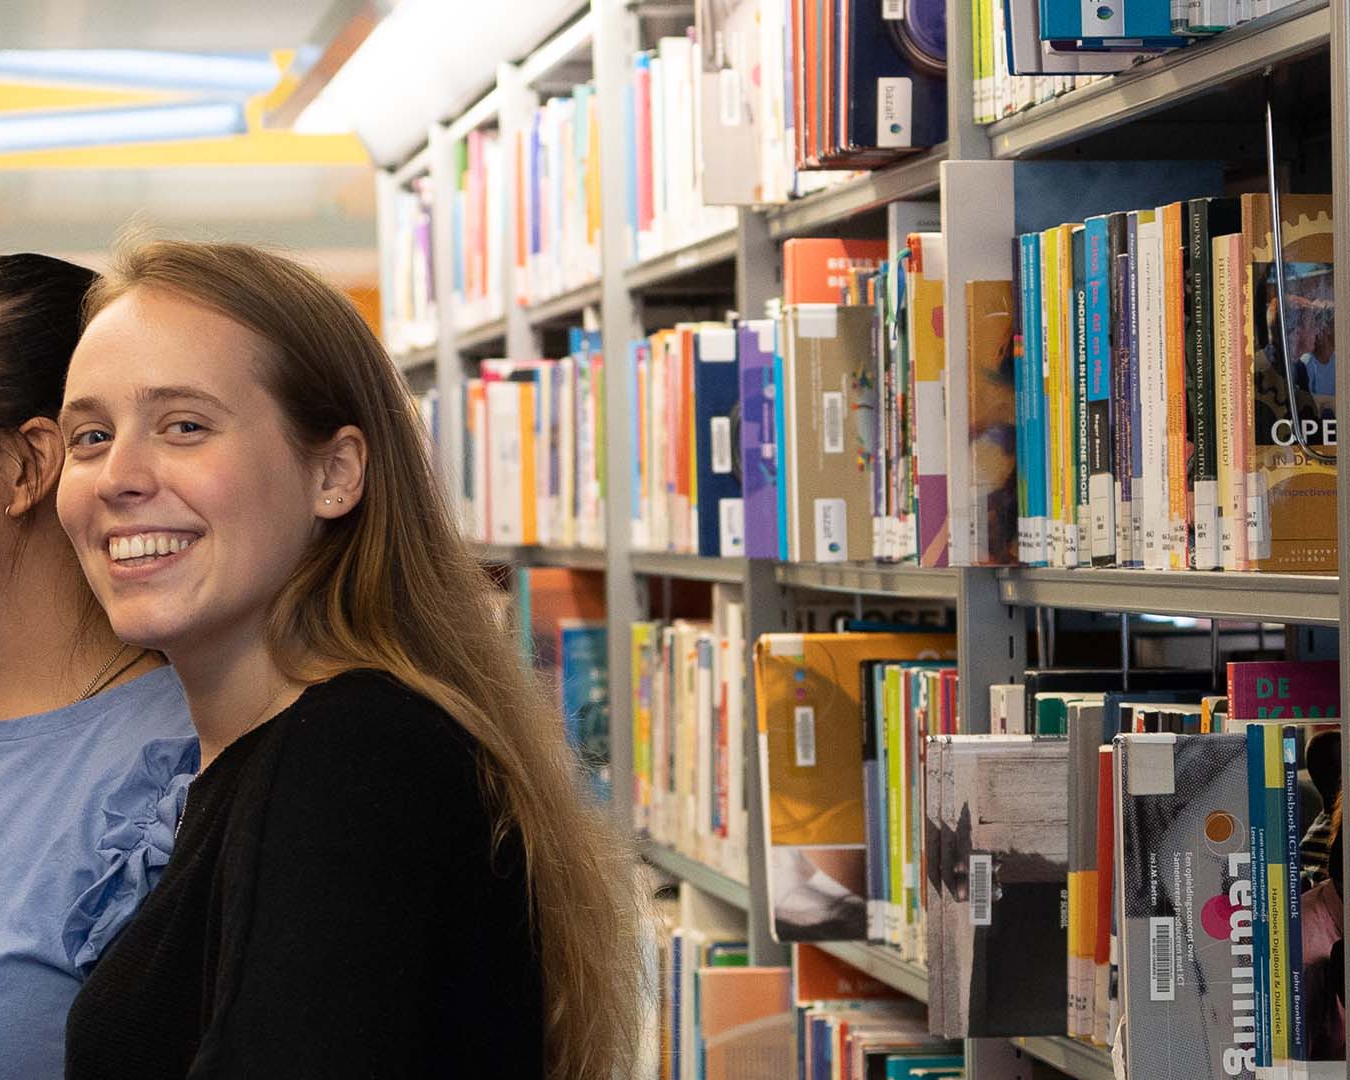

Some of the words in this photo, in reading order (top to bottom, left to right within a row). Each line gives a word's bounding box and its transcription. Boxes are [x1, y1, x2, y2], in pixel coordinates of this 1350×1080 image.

[1077, 290, 1086, 362] ONDERWIJS
[1219, 294, 1227, 327] ONZE
[1220, 330, 1228, 378] SCHOOL
[1079, 379, 1088, 462] HETEROGENE
[1257, 677, 1290, 698] DE
[1287, 771, 1296, 832] Basisboek
[1173, 851, 1182, 906] Samenlerend
[1288, 835, 1298, 918] ICT-didactiek
[1173, 907, 1182, 954] produceren
[1184, 868, 1194, 942] opleidingsconcept
[1293, 994, 1301, 1045] Bronkhorst
